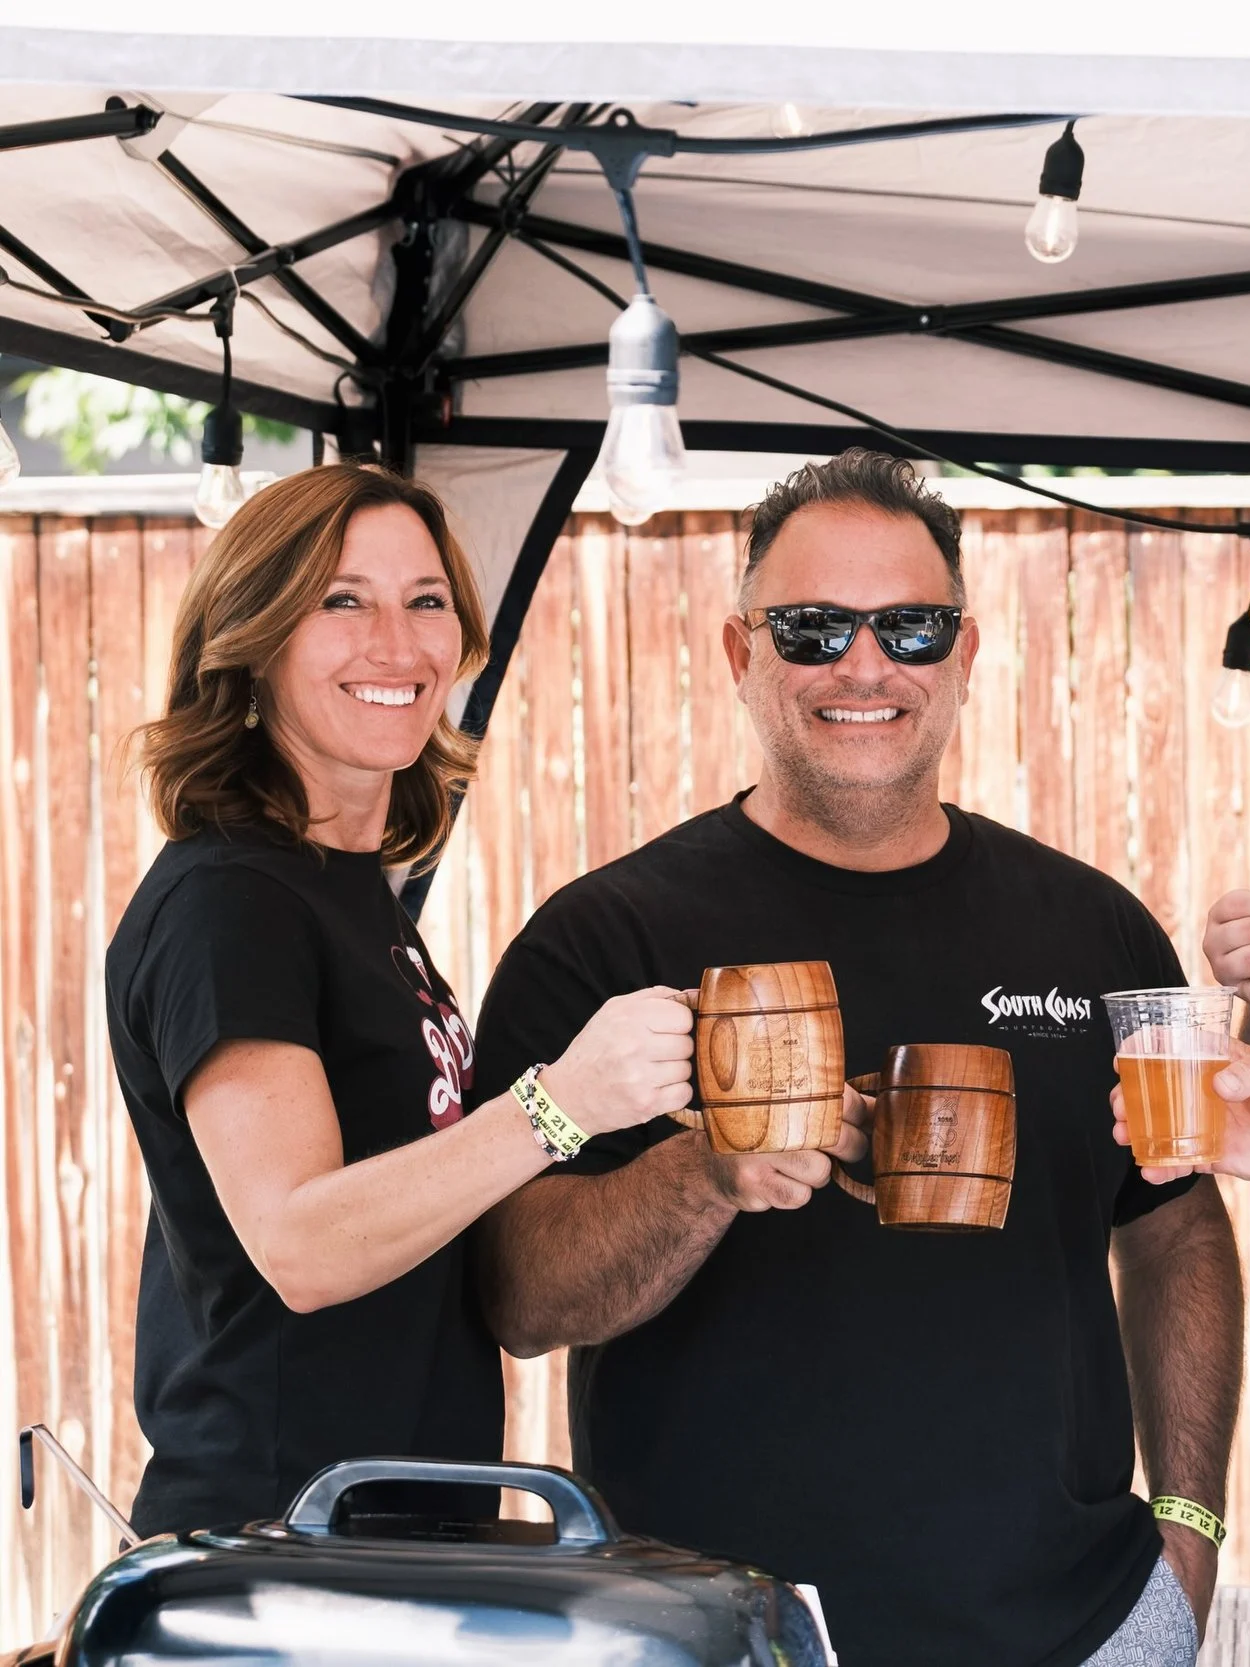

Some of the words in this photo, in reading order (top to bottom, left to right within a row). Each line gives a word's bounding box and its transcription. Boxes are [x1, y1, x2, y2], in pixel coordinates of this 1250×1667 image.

[981, 986, 1043, 1024] SOUTH
[1044, 986, 1091, 1026] COAST
[536, 1097, 551, 1114] 21
[551, 1115, 567, 1131] 21
[569, 1132, 583, 1146] 21
[1159, 1506, 1173, 1515] 21
[1180, 1510, 1194, 1521] 21
[1200, 1518, 1210, 1531] 21
